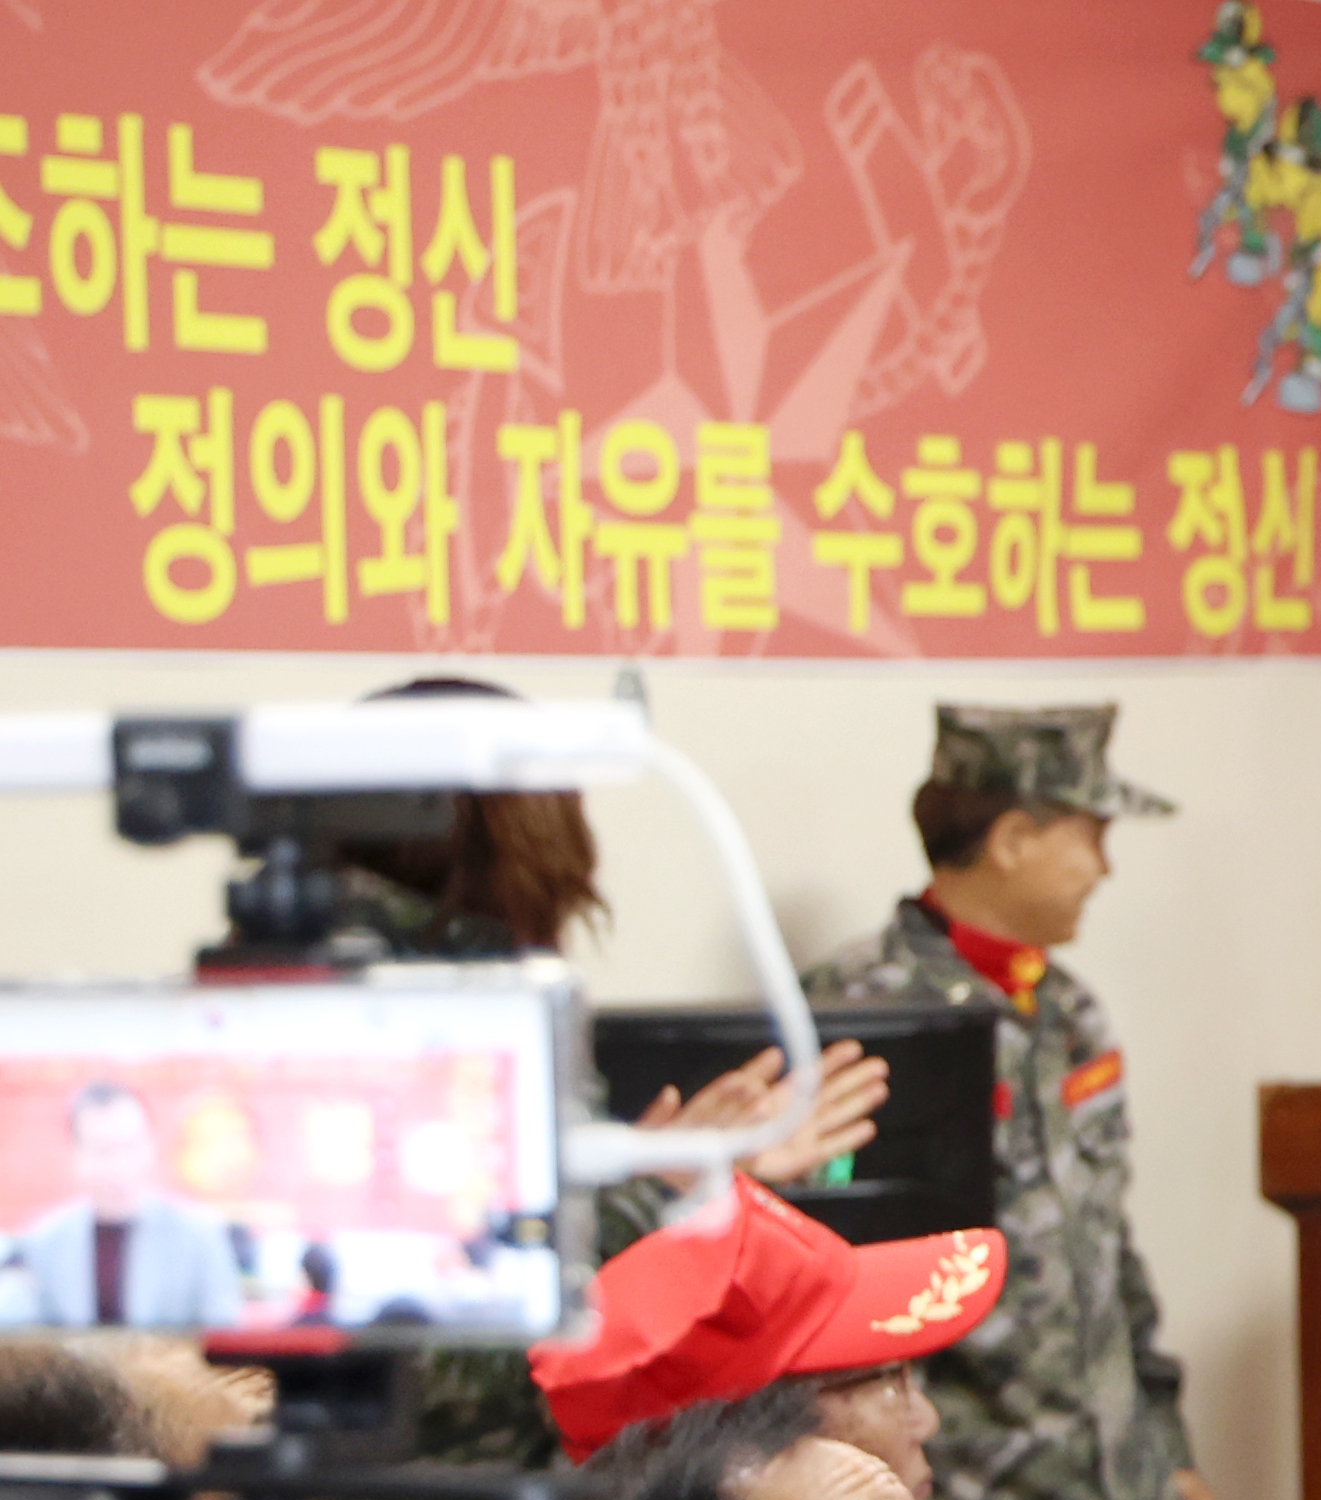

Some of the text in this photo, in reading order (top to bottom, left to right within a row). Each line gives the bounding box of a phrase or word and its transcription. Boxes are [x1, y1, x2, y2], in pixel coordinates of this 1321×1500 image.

[313, 144, 520, 373] 정신
[130, 386, 1318, 637] 정의와 자유를 수호하는 정신
